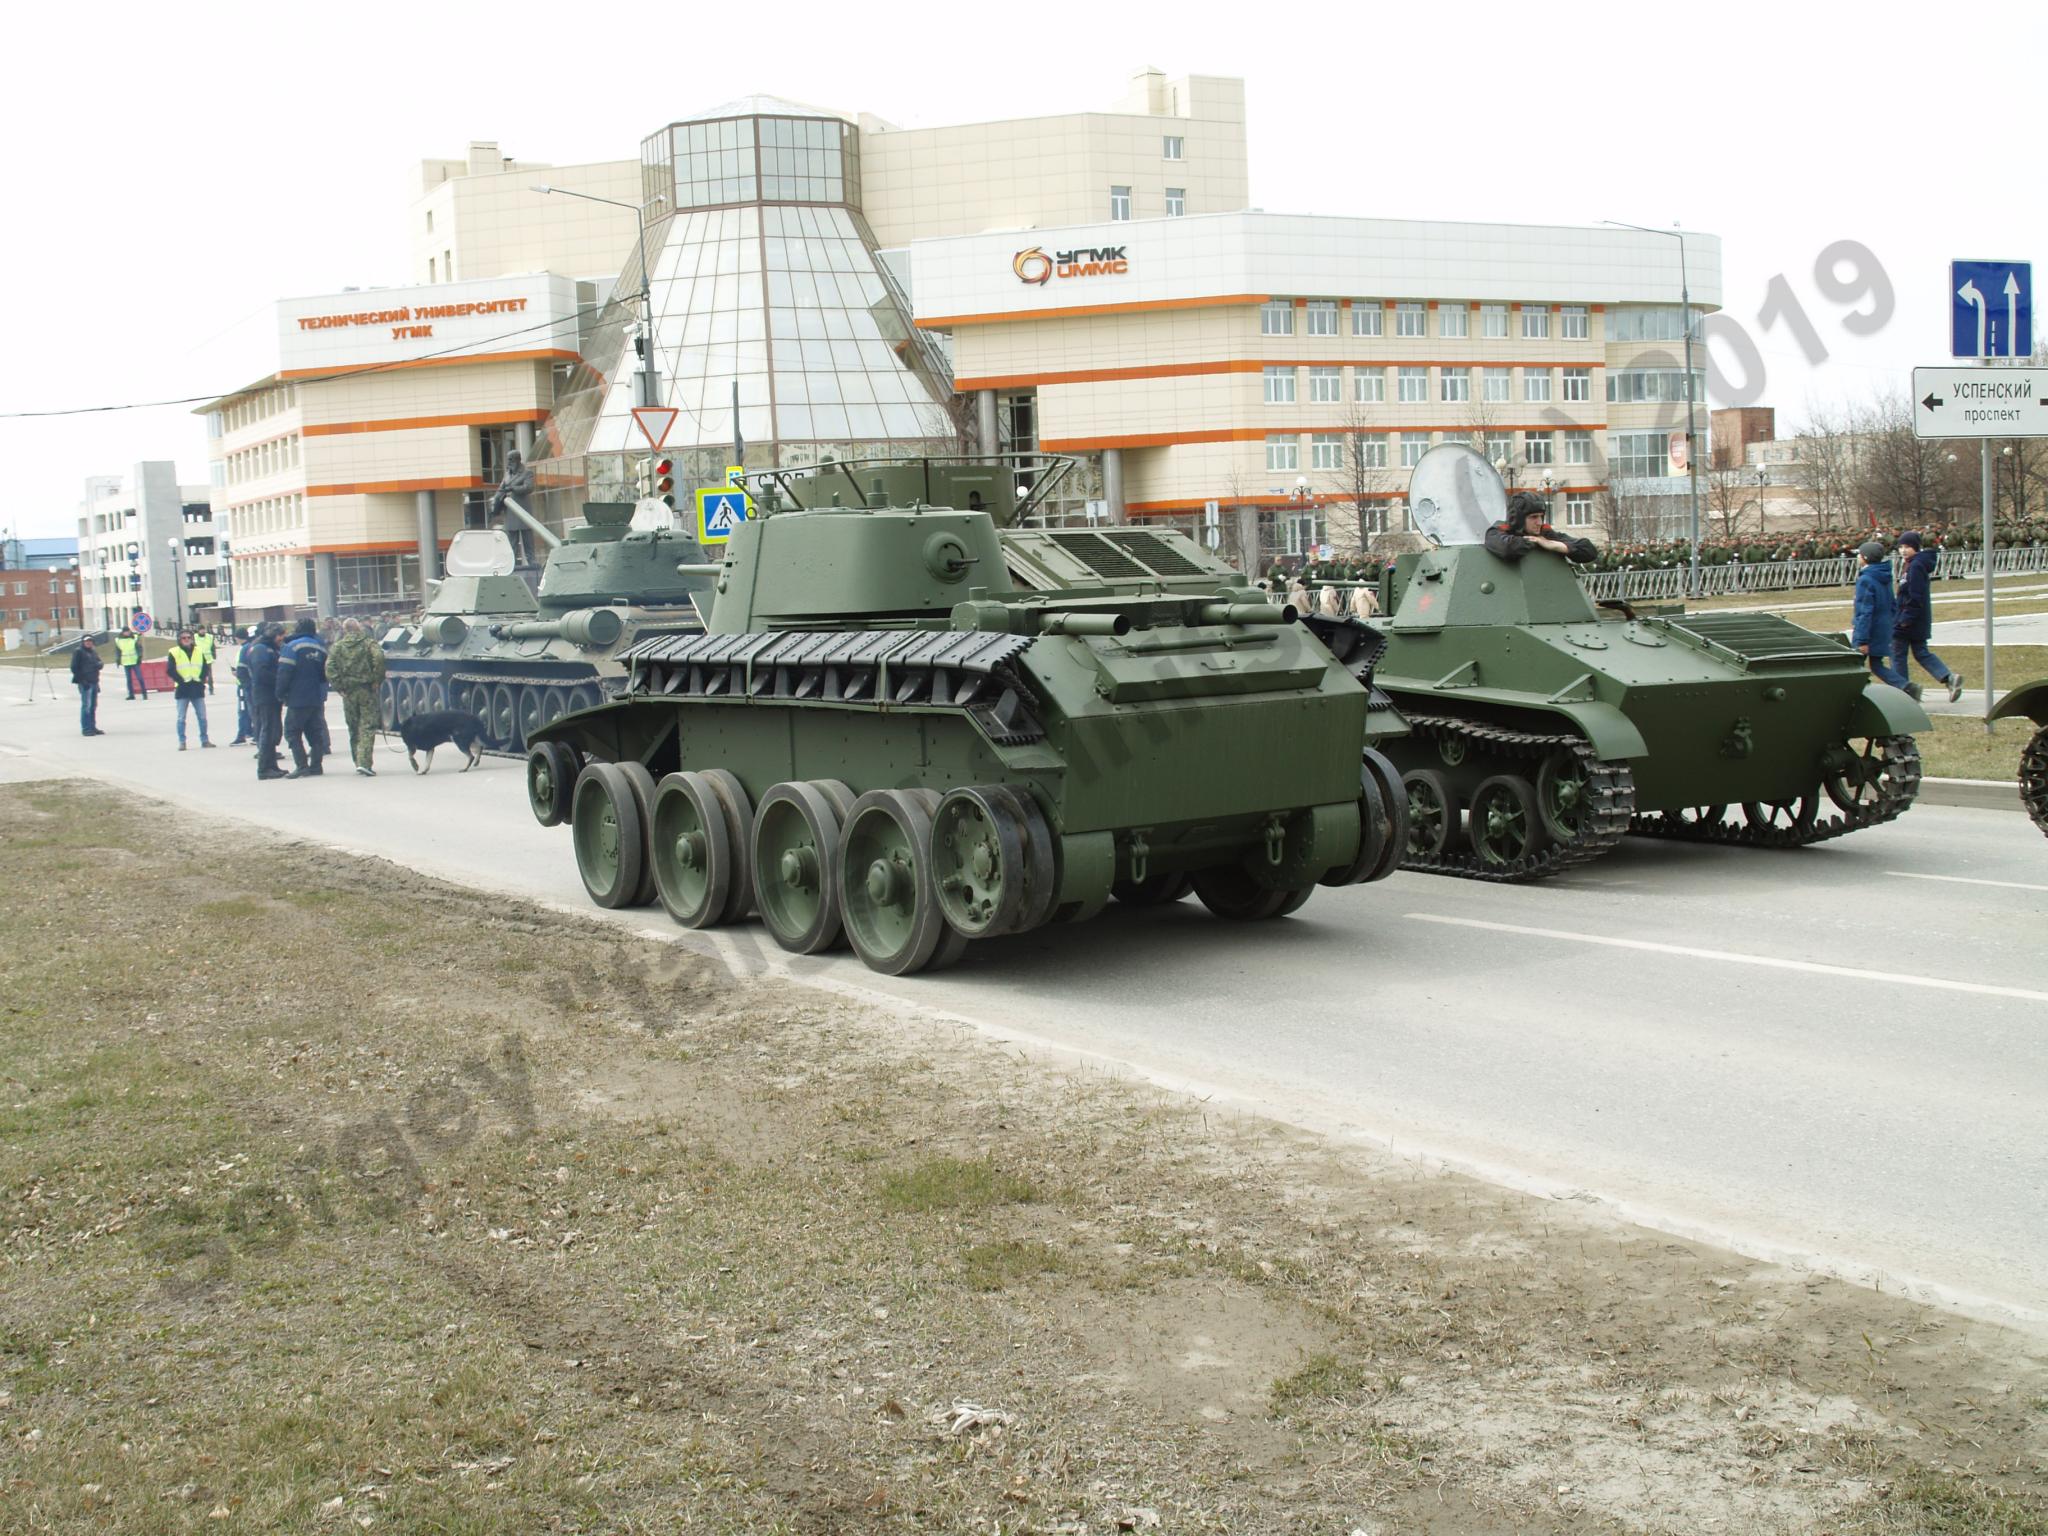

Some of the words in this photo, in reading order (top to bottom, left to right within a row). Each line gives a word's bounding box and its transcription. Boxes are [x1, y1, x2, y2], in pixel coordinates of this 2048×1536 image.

[1056, 246, 1126, 264] УГМК
[1056, 260, 1128, 278] UMMC
[297, 306, 410, 330] ТЕХНИЧЕСКИЙ
[414, 298, 528, 321] УНИВЕРСИТЕТ
[391, 325, 433, 340] УГМК
[1952, 378, 2032, 399] УСПЕНСКИЙ
[1964, 409, 2021, 425] проспект
